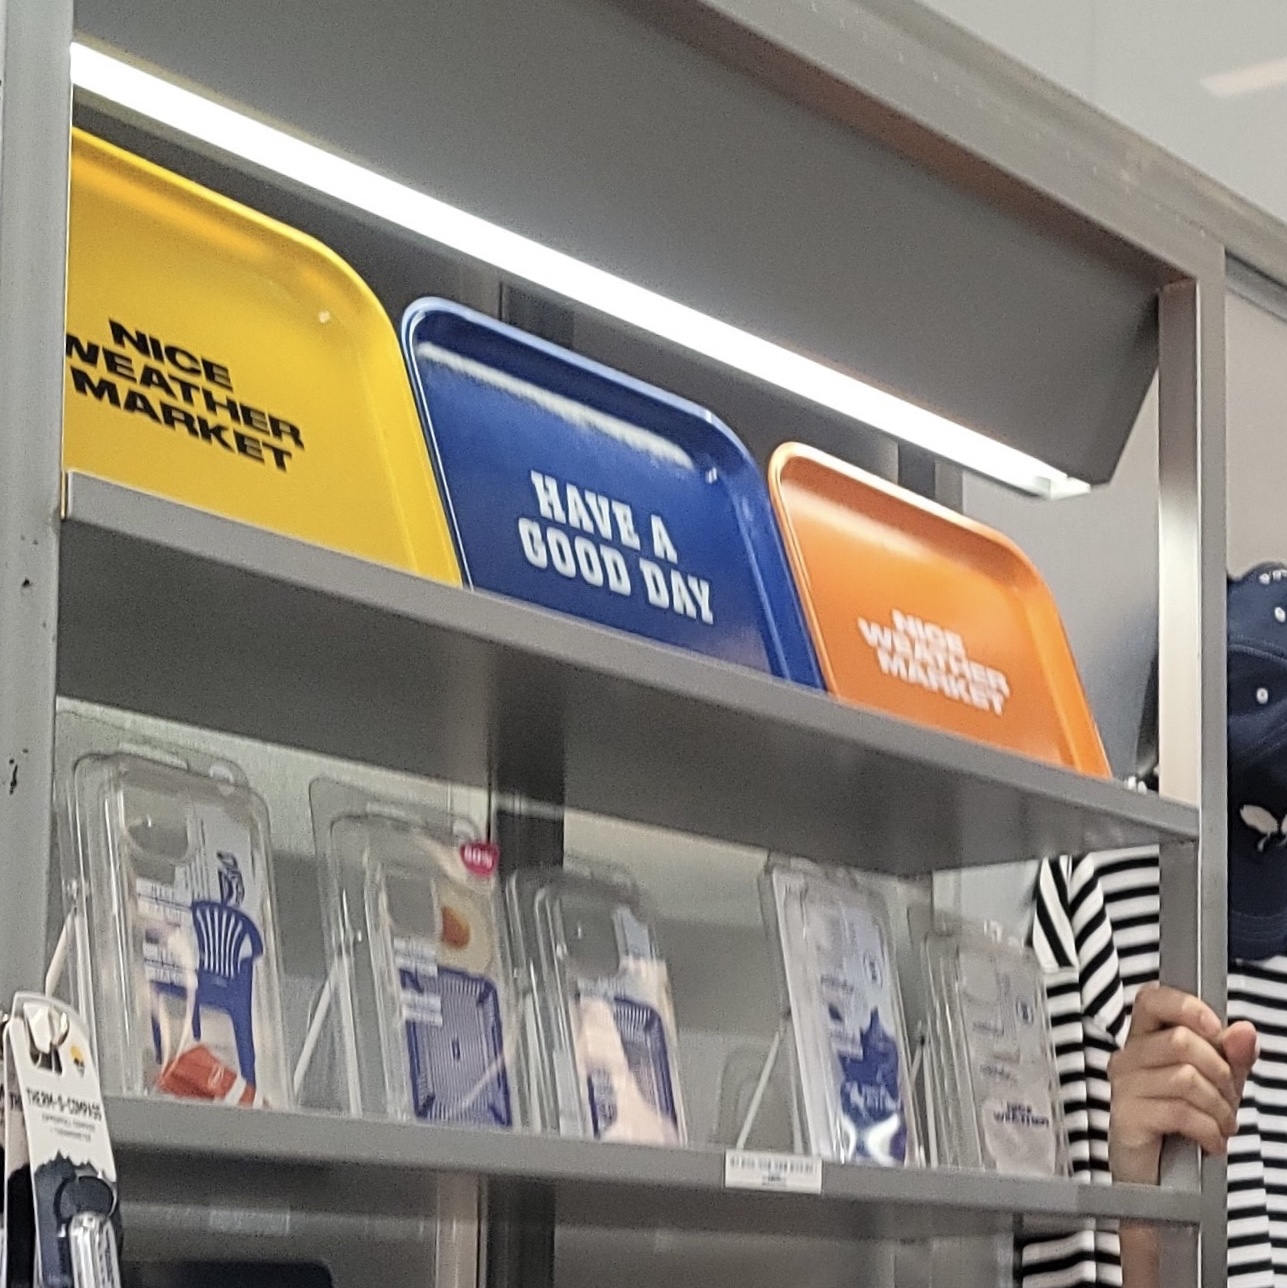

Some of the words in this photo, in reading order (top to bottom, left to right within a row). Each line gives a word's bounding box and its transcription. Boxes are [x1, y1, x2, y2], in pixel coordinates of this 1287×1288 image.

[108, 318, 233, 392] NICE
[69, 365, 293, 474] MARKET
[530, 469, 641, 551] HAVE
[650, 513, 678, 565] A
[518, 516, 632, 596] GOOD
[639, 556, 714, 625] DAY
[876, 648, 1004, 717] MARKET
